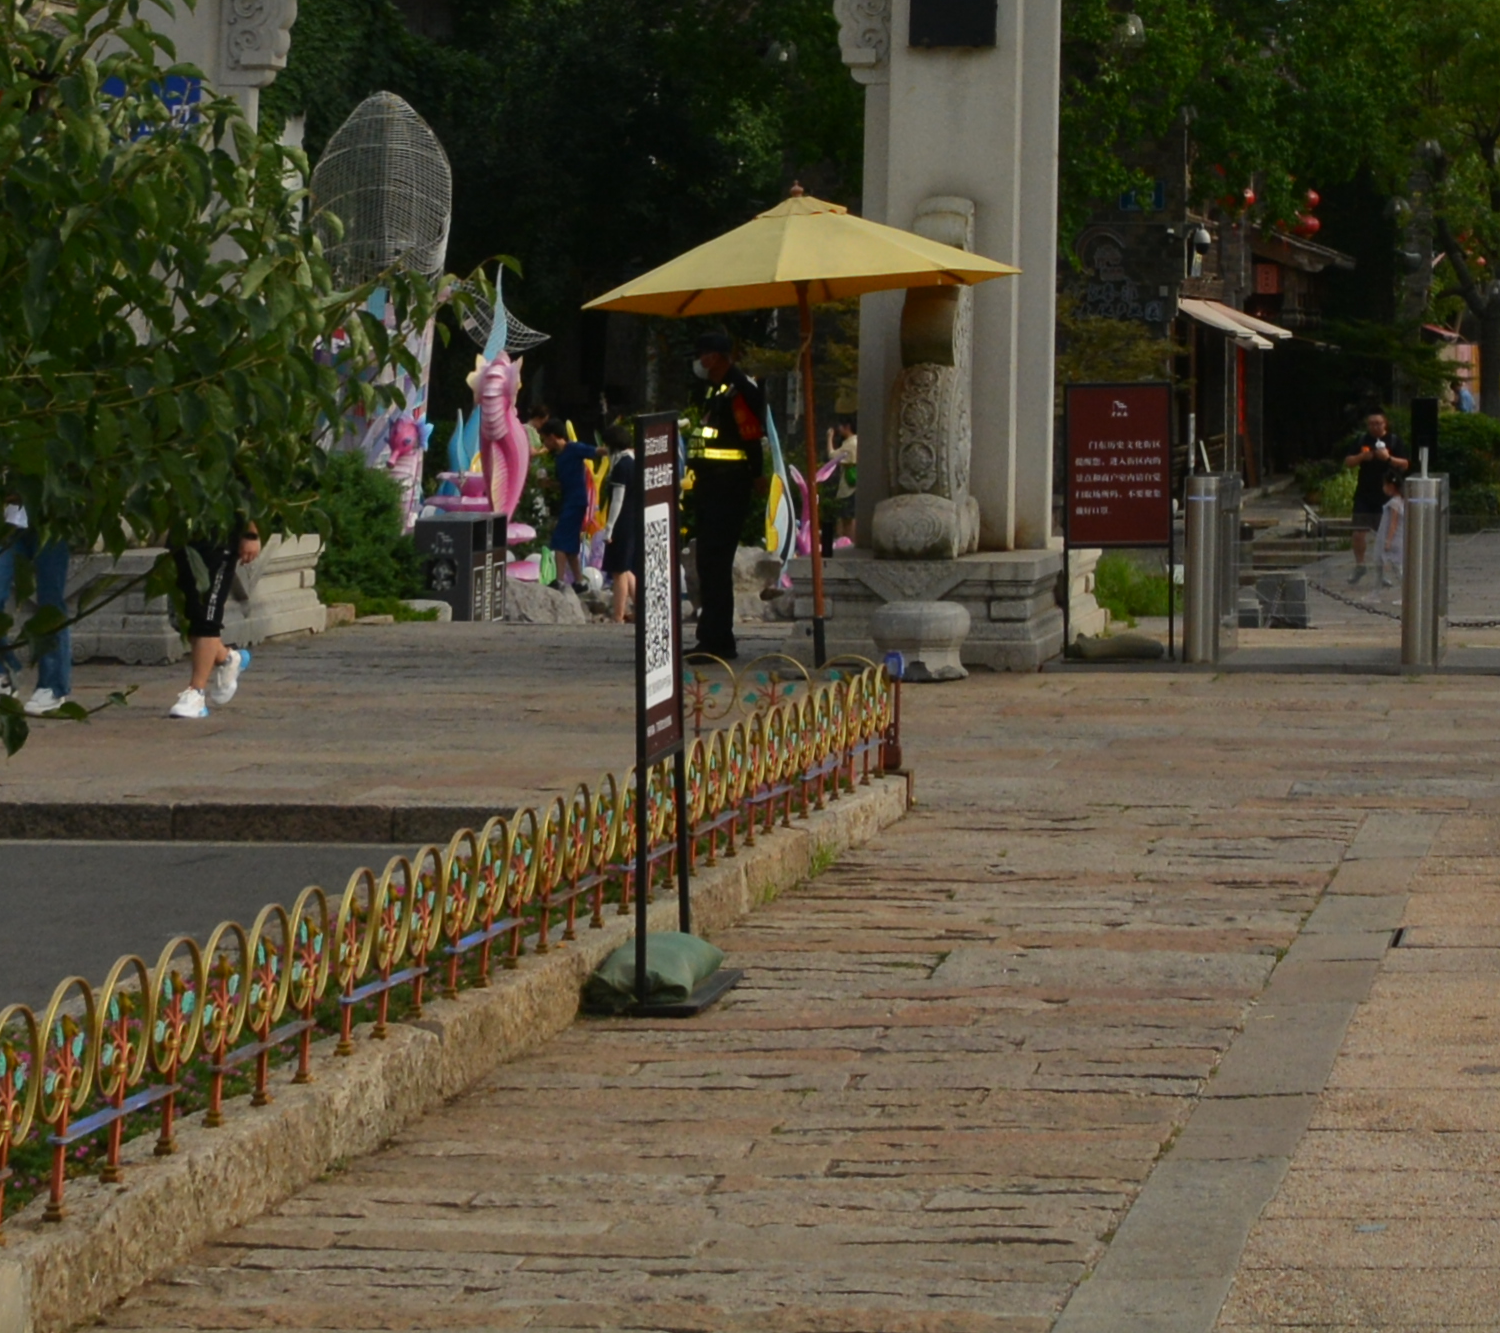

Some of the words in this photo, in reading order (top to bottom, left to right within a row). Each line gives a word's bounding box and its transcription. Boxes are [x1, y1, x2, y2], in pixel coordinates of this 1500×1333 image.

[1088, 440, 1161, 450] 门东历史文化街区
